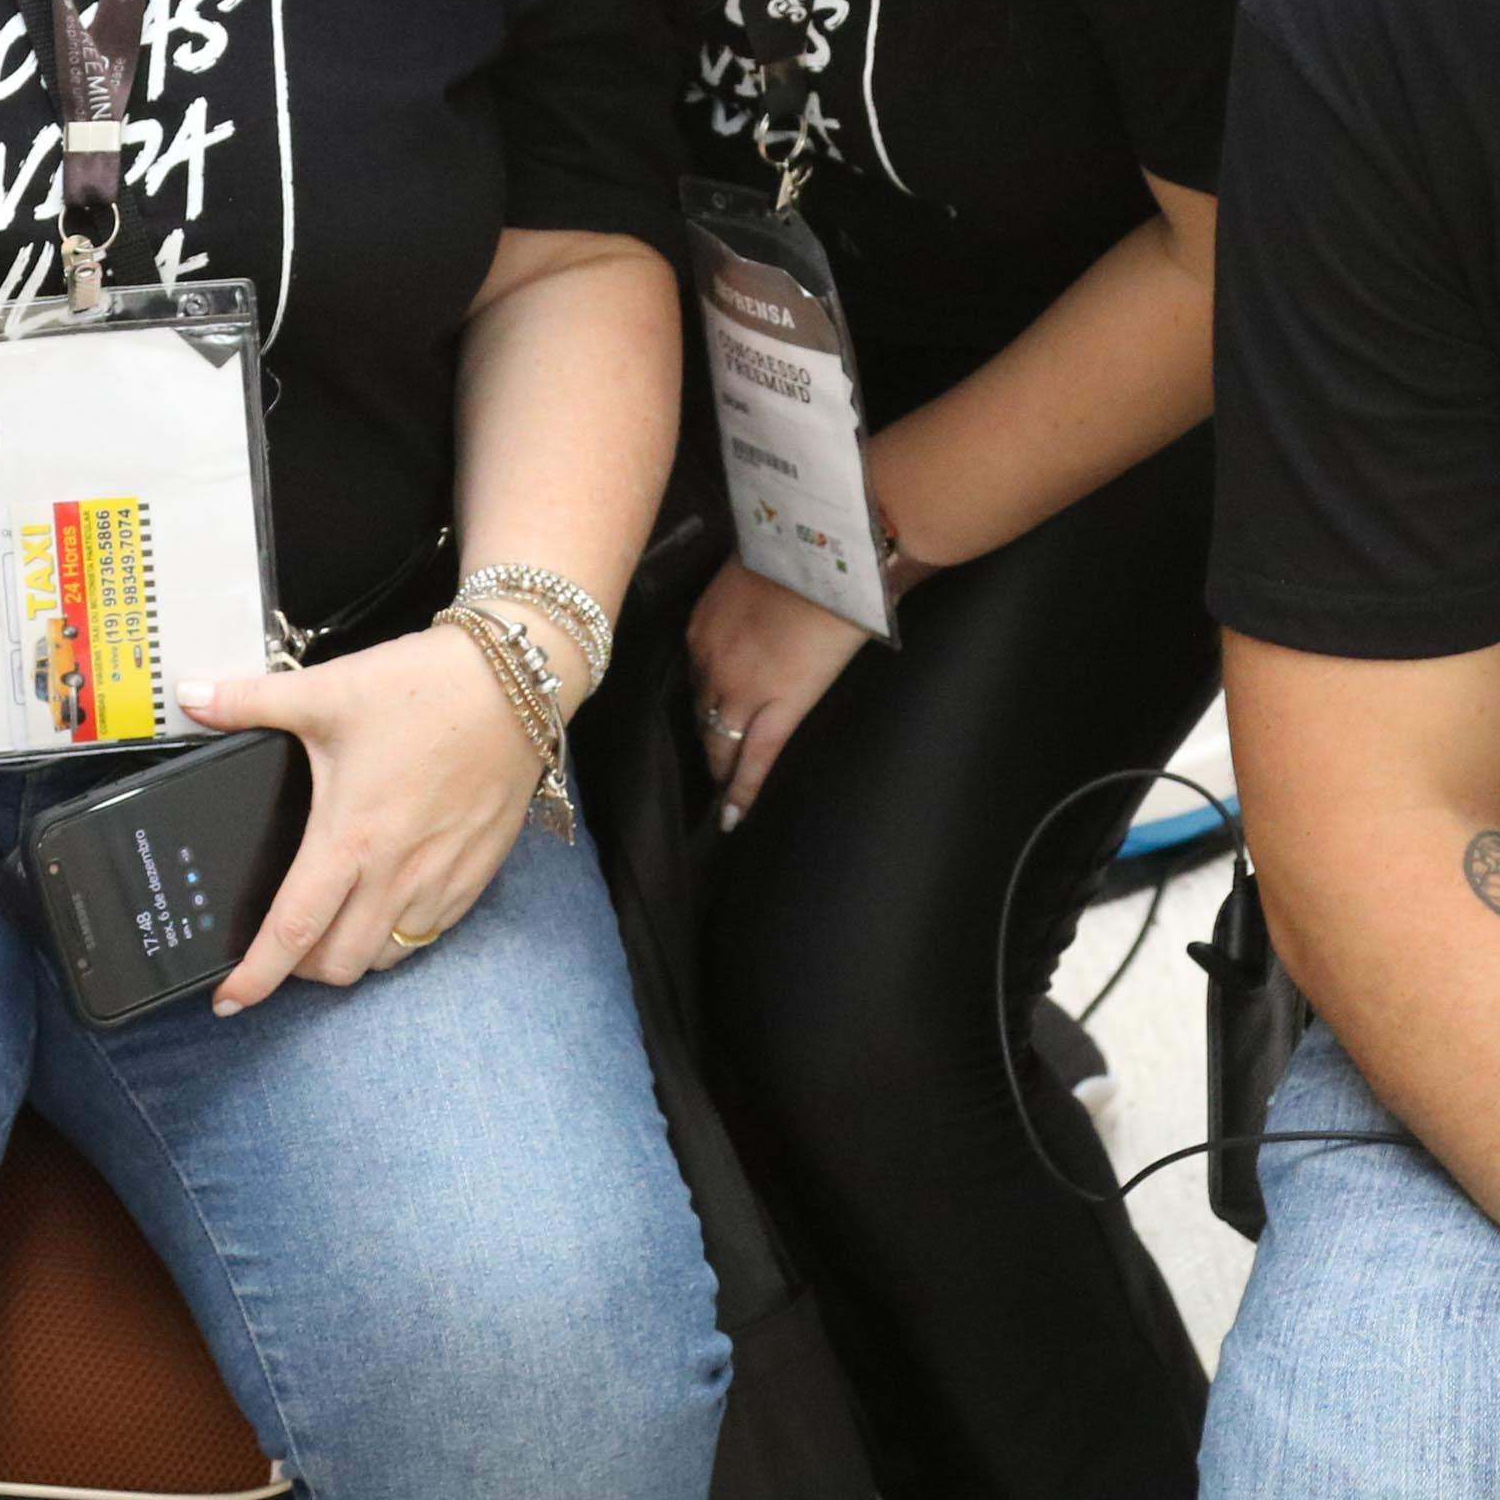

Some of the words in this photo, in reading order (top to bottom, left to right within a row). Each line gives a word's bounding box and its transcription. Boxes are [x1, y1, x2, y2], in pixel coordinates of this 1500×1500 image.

[82, 30, 112, 121] REEMIN
[62, 525, 80, 579] Horas
[83, 510, 95, 561] PARTICULAR
[96, 510, 117, 607] 99736.5866
[117, 508, 138, 606] 98349.7074
[20, 524, 57, 620] TAXI
[63, 582, 81, 605] 24
[103, 612, 121, 644] (19)
[125, 610, 143, 643] (19)
[135, 829, 161, 892] dezembro
[154, 892, 166, 910] de
[158, 911, 170, 921] 6
[136, 911, 161, 957] 17:48
